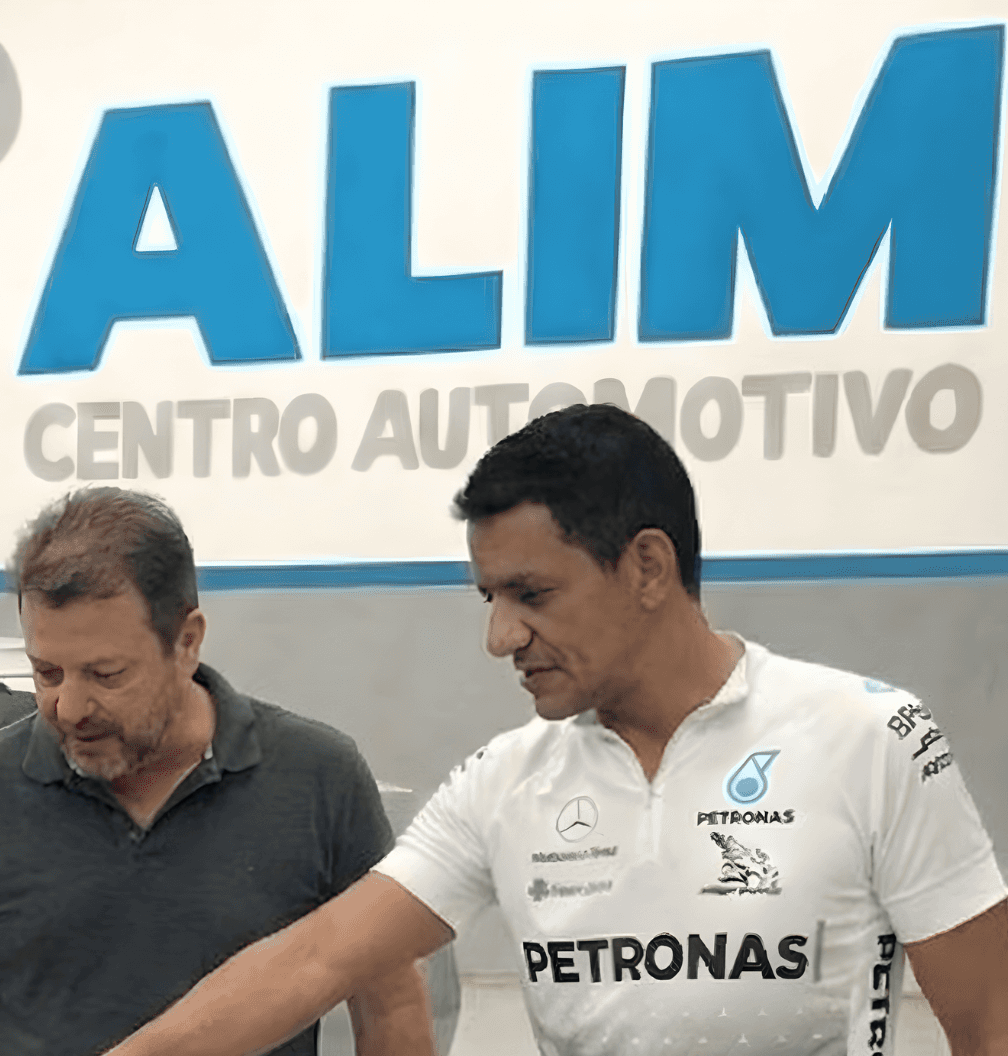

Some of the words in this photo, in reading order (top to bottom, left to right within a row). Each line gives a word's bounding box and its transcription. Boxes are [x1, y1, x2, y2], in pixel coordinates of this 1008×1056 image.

[17, 24, 1005, 376] ALIM
[23, 392, 338, 482] CENTRO
[523, 932, 810, 984] PETRONAS
